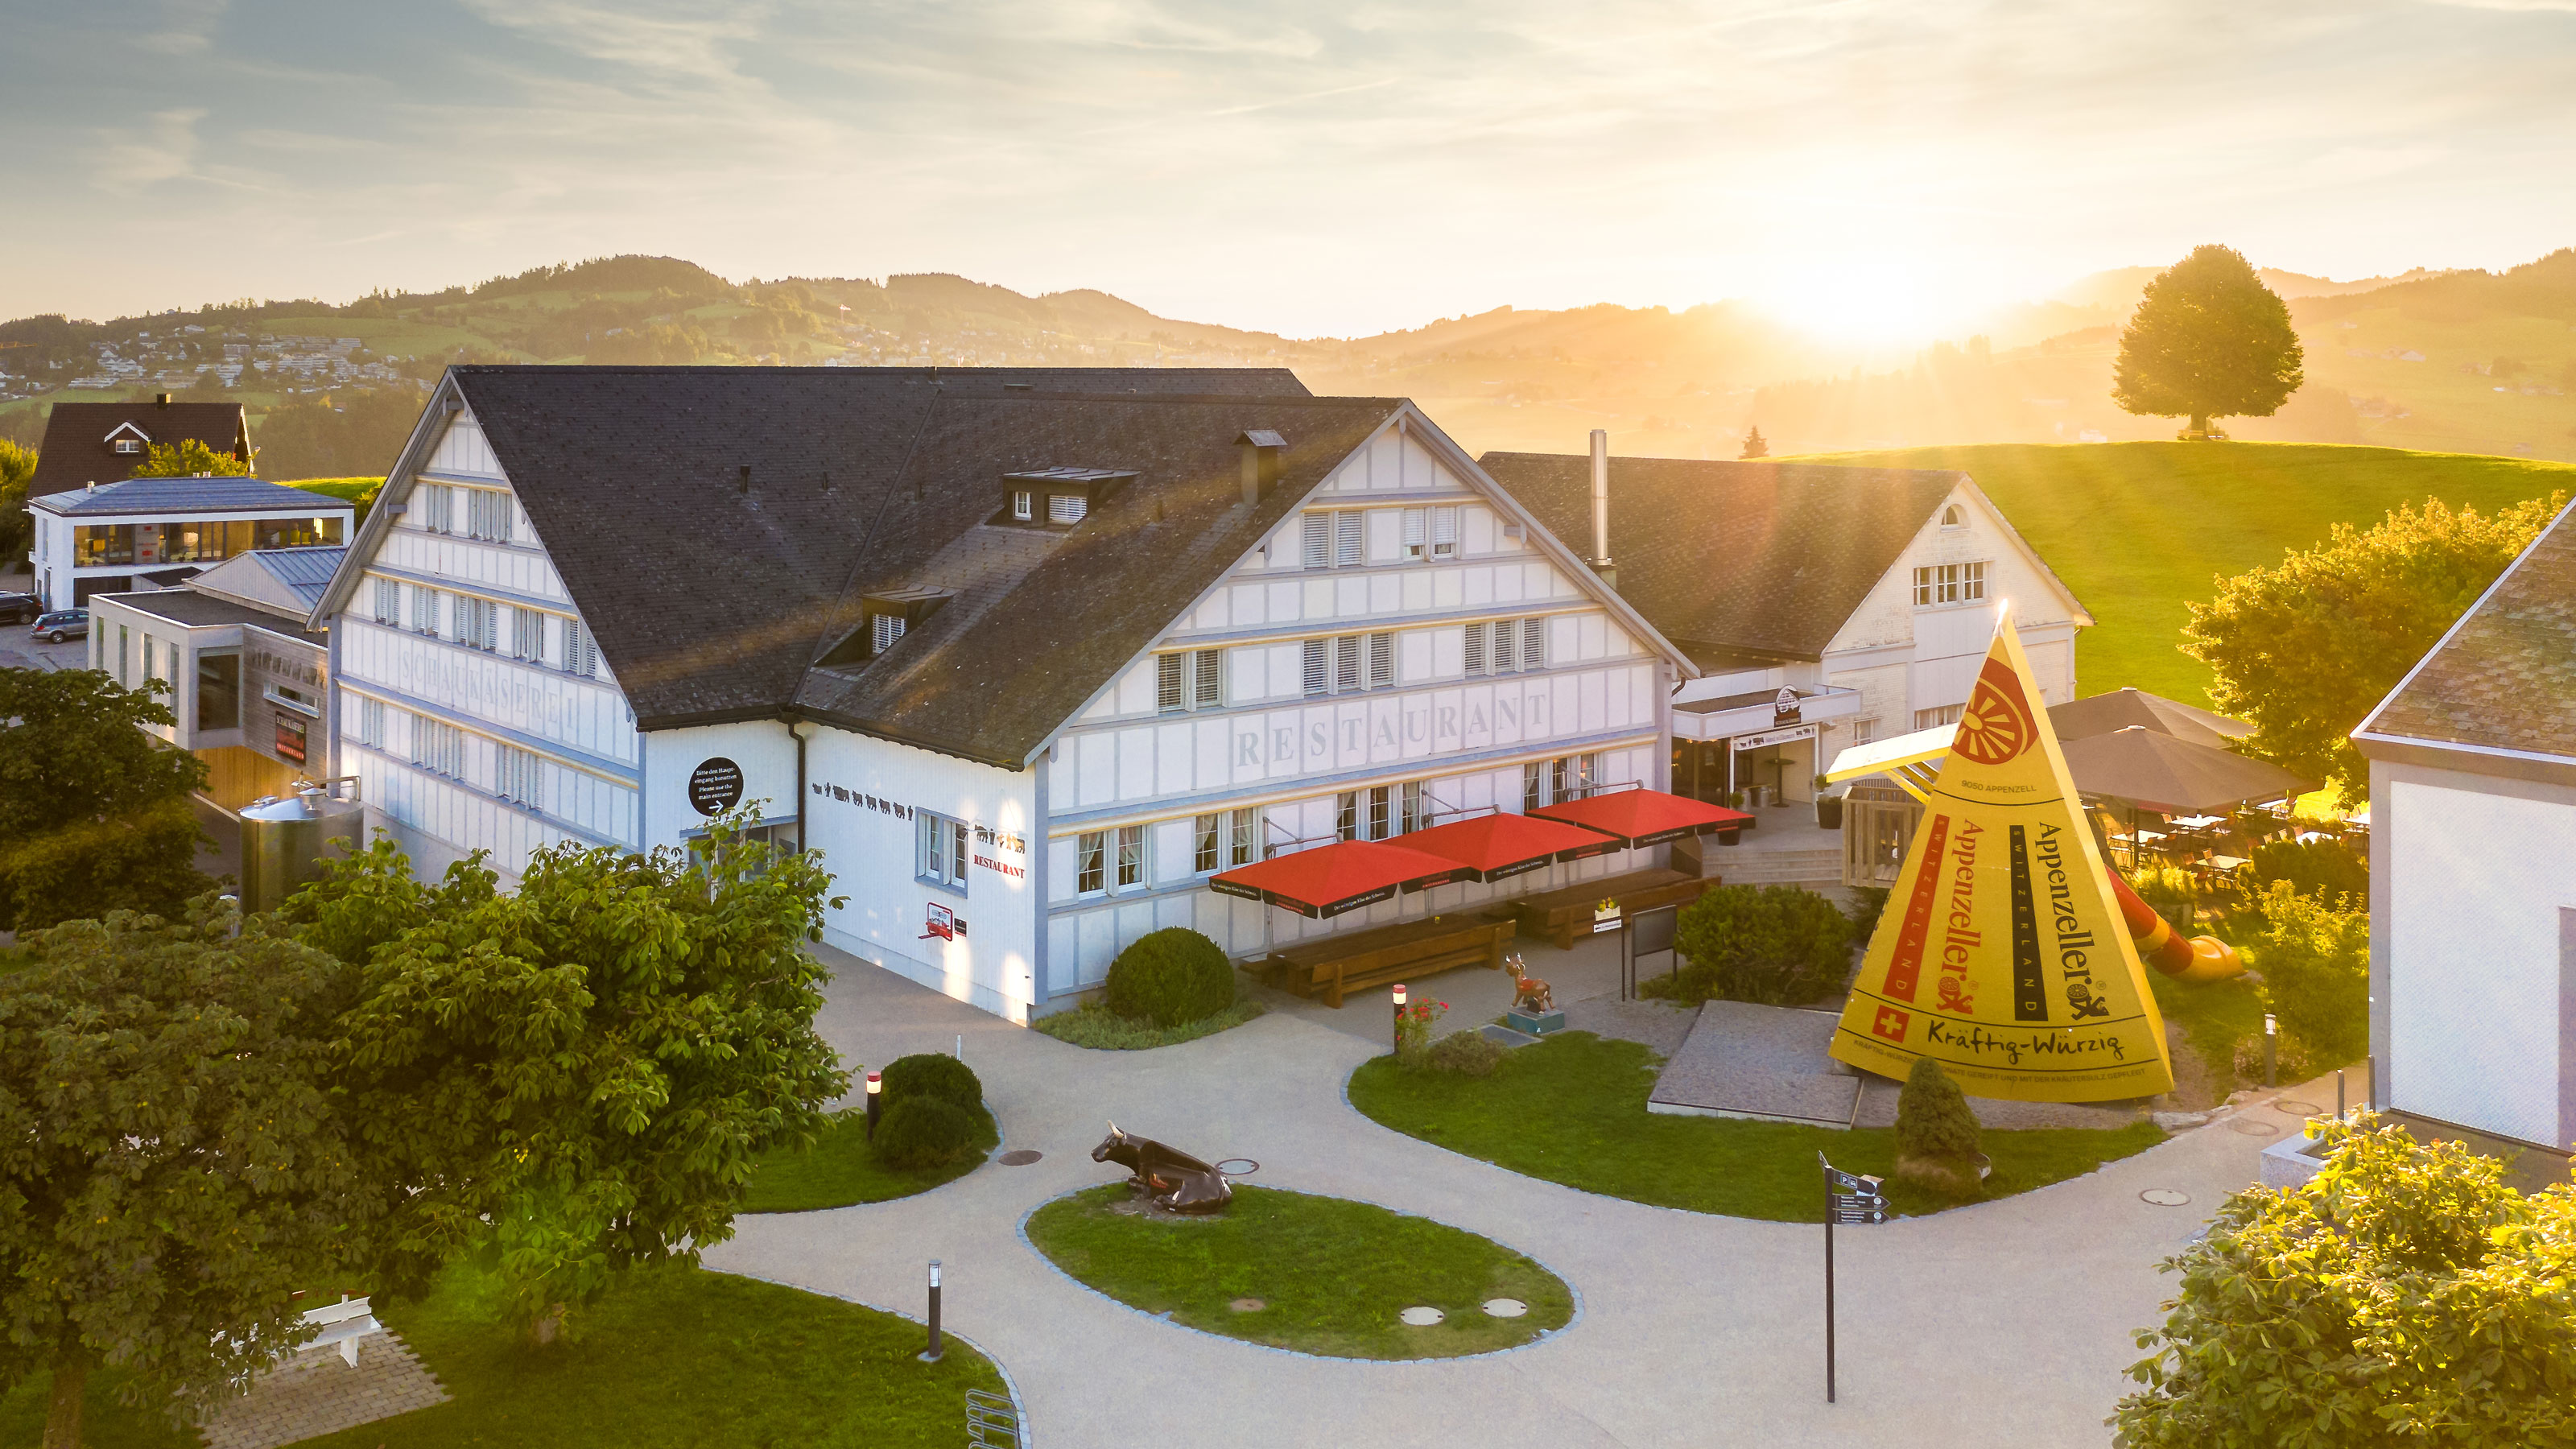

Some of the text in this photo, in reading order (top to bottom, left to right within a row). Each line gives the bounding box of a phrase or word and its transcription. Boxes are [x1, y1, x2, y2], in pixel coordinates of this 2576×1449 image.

[402, 650, 573, 729] SCHAUKÄSEREI
[1236, 694, 1546, 767] RESTAURANT
[1961, 780, 2037, 793] 9050 APPENZELL
[973, 854, 1025, 879] RESTAURANT
[1941, 819, 1984, 981] Appenzeller
[2035, 821, 2095, 985] Appenzeller
[1896, 820, 1945, 990] SWITZERLAND
[2013, 831, 2037, 1011] SWITZERLAND
[1927, 1020, 2124, 1065] Kräftig-Würzig
[1967, 1071, 1998, 1080] GEREIFT
[2108, 1068, 2145, 1080] GEPFLEGT
